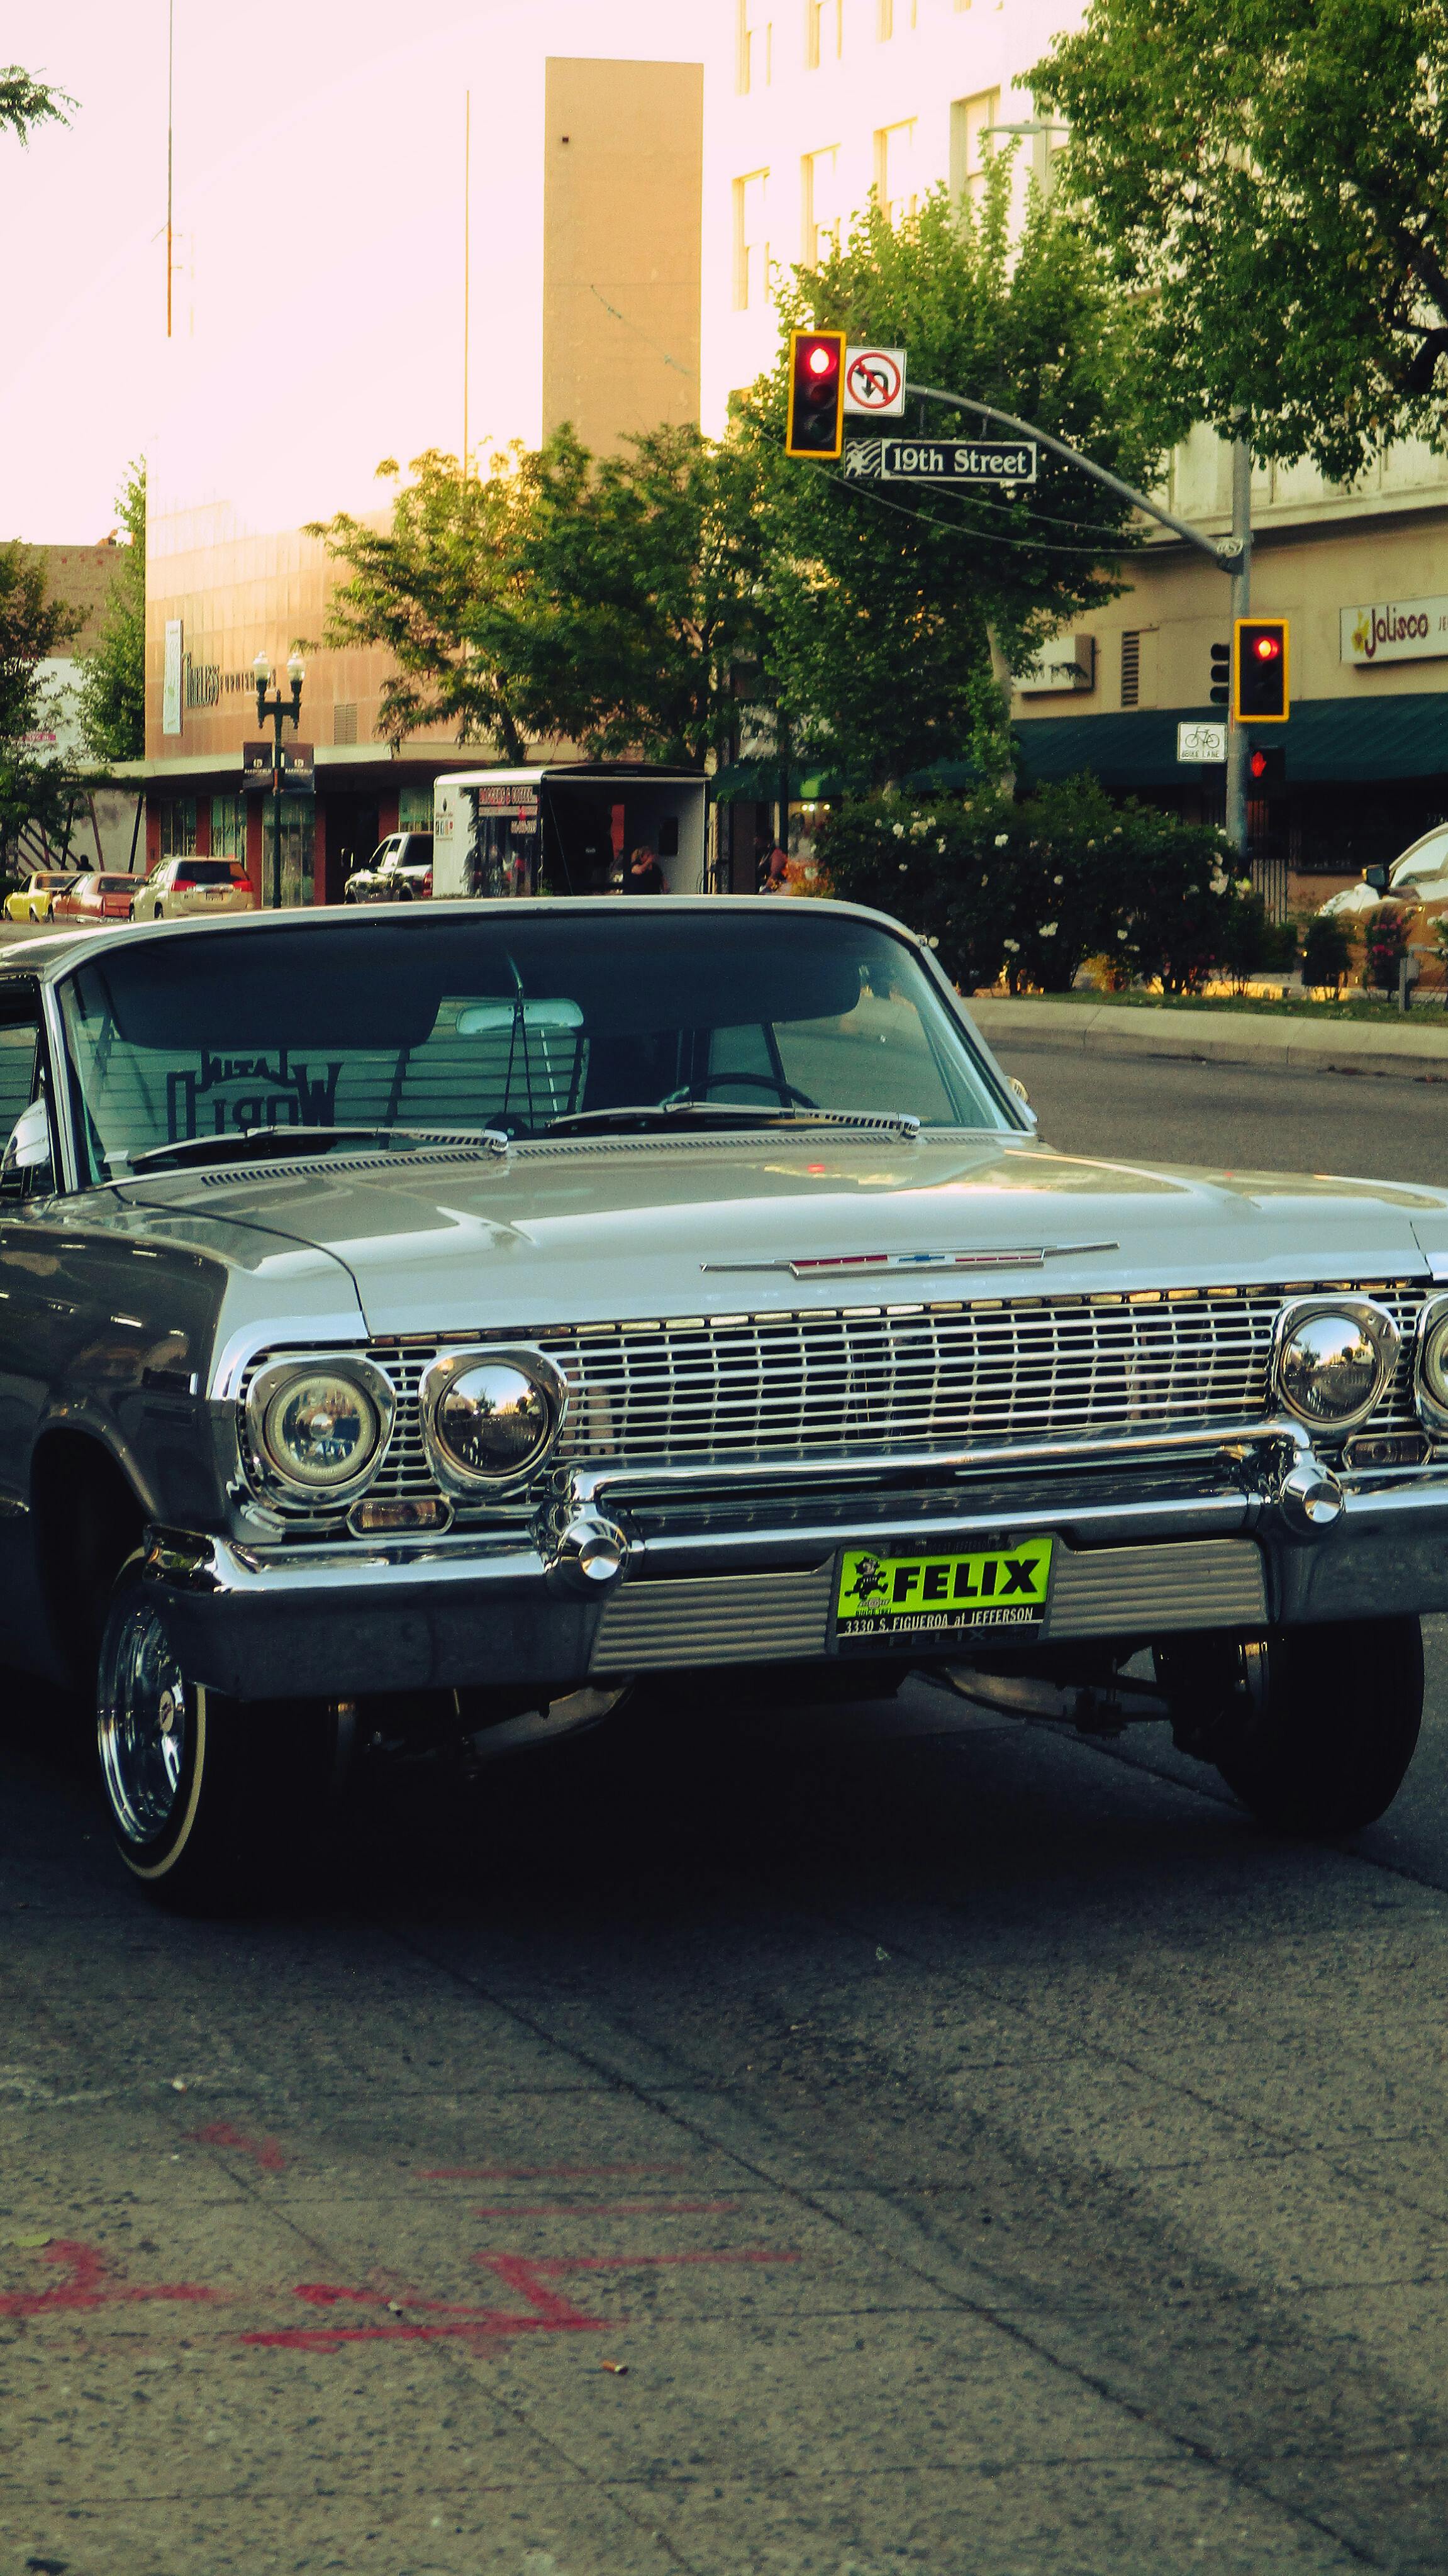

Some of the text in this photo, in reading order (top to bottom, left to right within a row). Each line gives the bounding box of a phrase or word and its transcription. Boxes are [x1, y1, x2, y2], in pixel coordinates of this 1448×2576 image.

[893, 447, 1027, 474] 19th Street
[1364, 604, 1429, 658] Jalisco
[1184, 749, 1220, 758] BIKE LANE
[891, 1558, 1041, 1603] FELIX
[845, 1607, 1034, 1634] 3330 S. FIGUEROA at JEFFERSON
